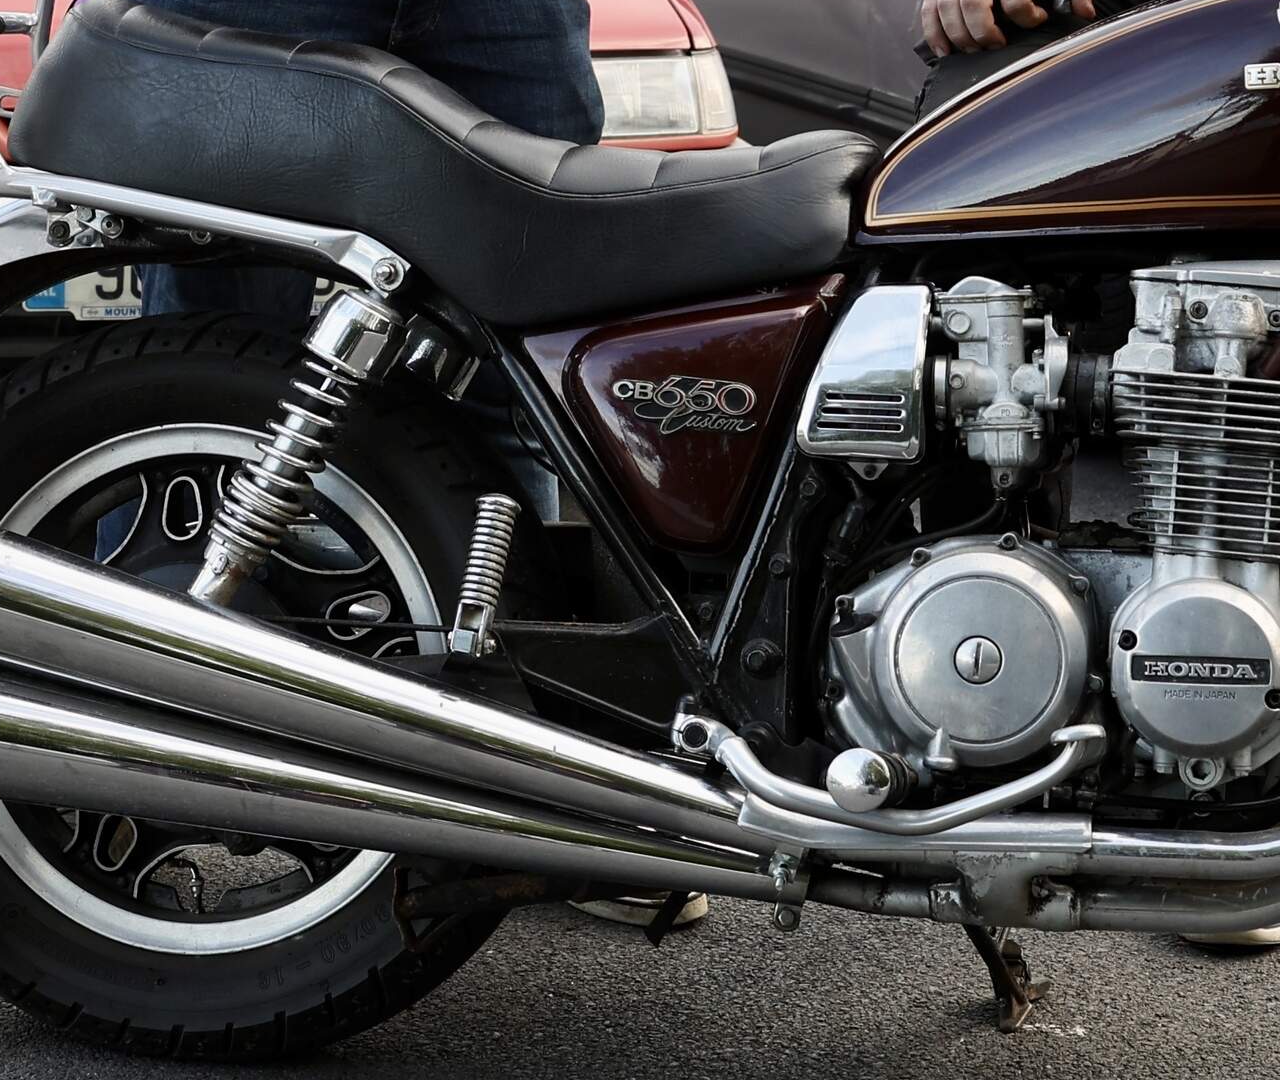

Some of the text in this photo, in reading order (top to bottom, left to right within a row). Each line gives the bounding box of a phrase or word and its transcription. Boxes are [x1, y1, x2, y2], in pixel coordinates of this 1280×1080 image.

[634, 402, 757, 435] Custom
[1144, 660, 1257, 679] HONDA
[1164, 689, 1237, 701] MADE IN JAPAN
